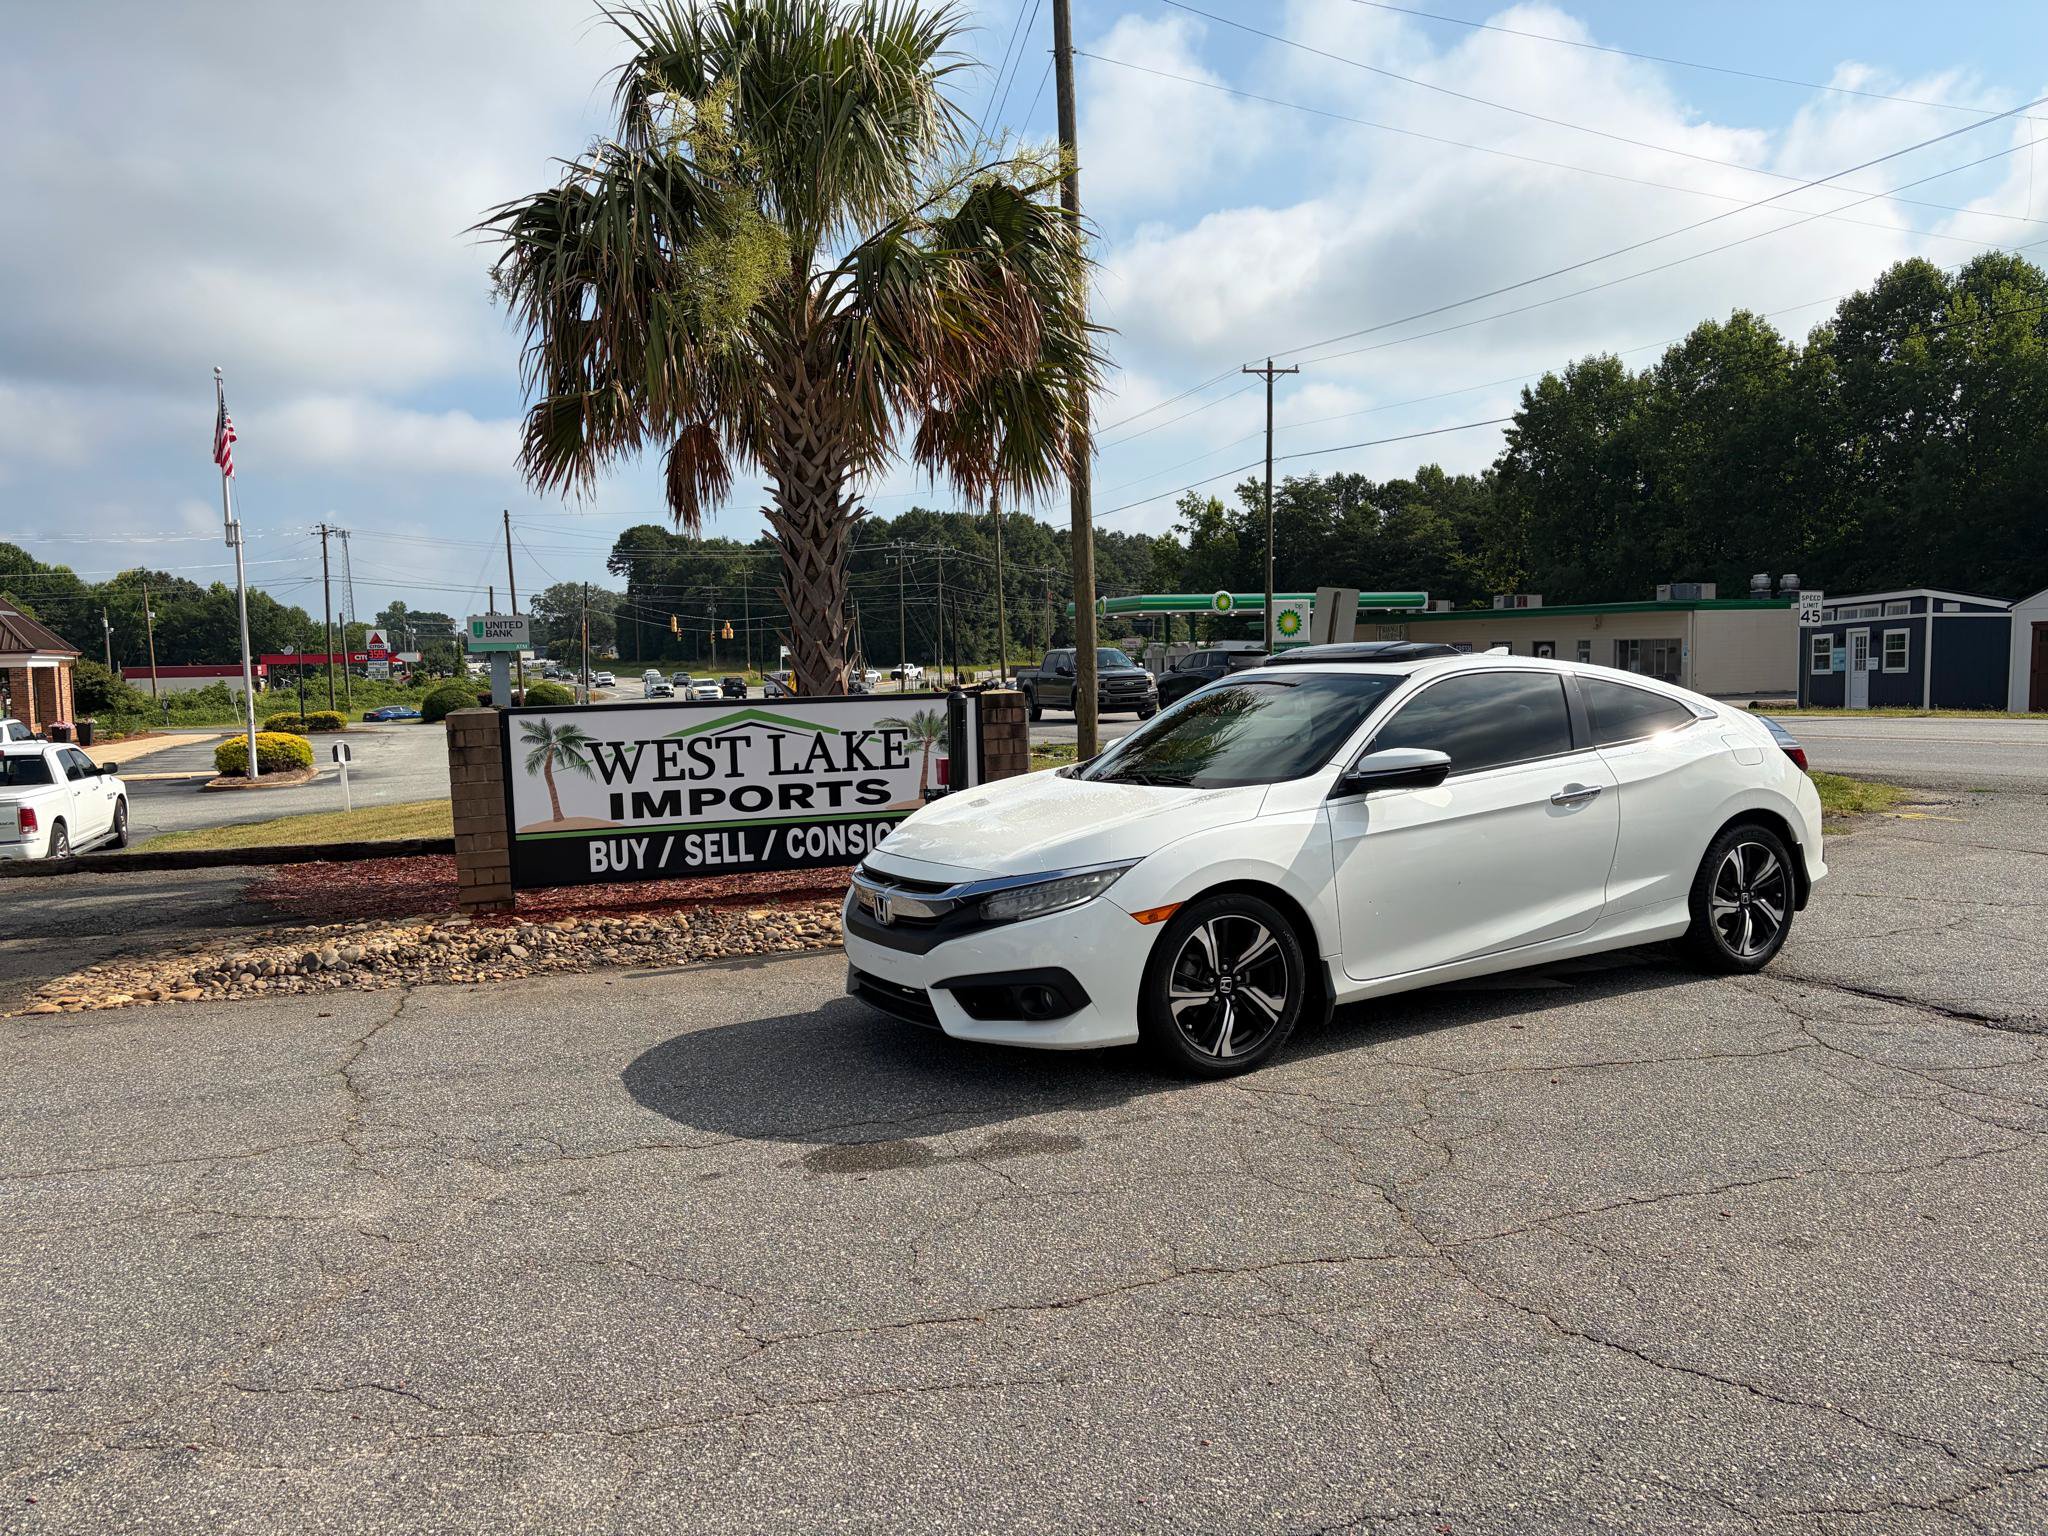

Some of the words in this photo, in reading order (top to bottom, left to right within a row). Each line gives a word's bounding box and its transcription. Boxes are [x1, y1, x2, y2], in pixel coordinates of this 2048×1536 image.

[485, 621, 523, 629] UNITED
[1801, 610, 1820, 623] 45
[485, 630, 513, 638] BANK
[584, 735, 751, 785] WEST
[767, 729, 910, 776] LAKE
[609, 778, 892, 821] IMPORTS
[589, 837, 650, 873] BUY
[658, 835, 676, 869] /
[684, 831, 755, 867] SELL
[761, 829, 778, 861] /
